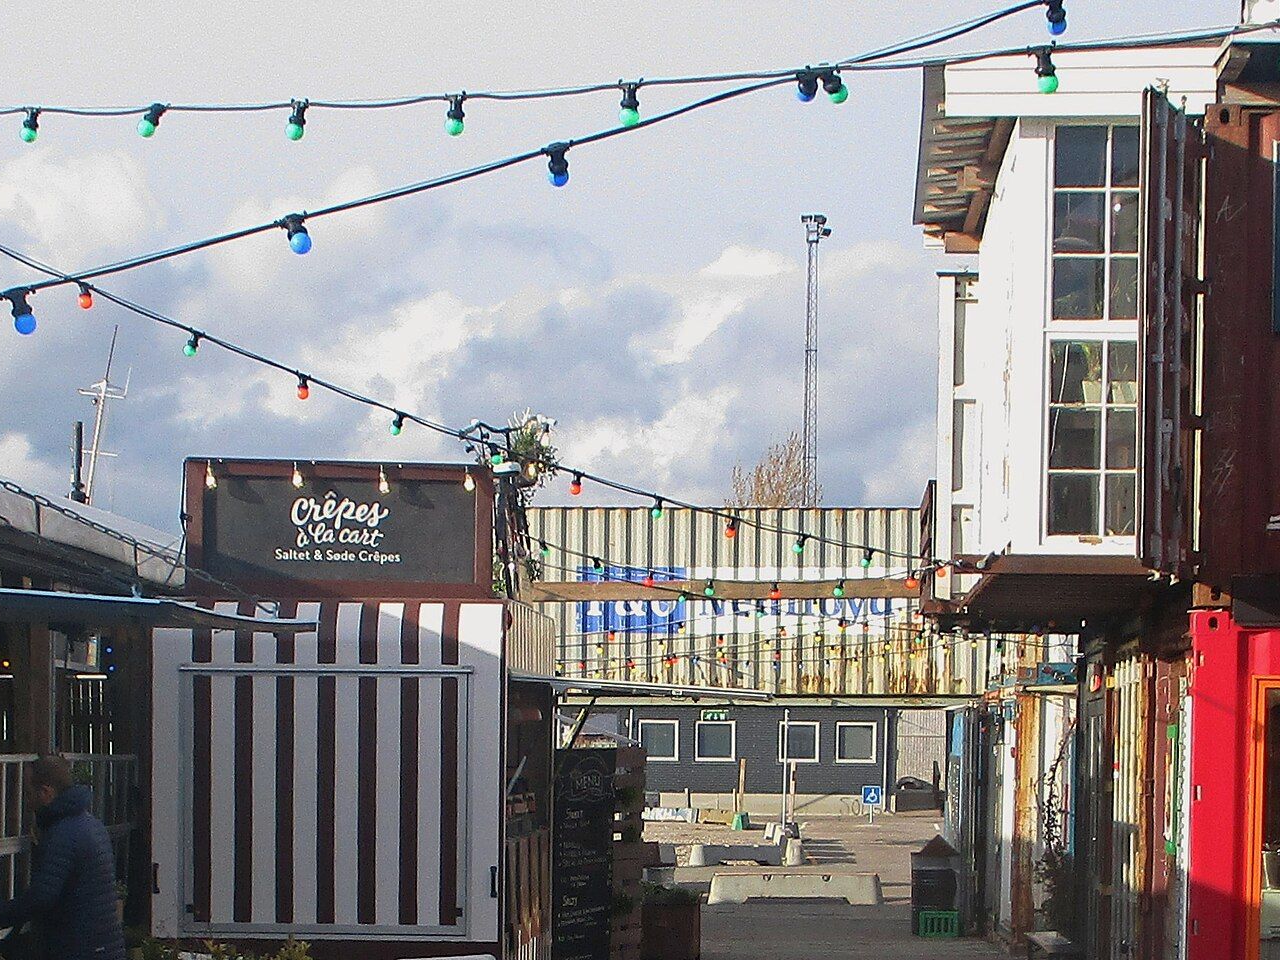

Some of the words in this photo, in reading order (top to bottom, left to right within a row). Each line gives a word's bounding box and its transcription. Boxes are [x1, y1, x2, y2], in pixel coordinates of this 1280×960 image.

[290, 491, 390, 528] Crêpes
[296, 525, 310, 547] à
[307, 522, 336, 545] la
[338, 525, 384, 547] cart
[274, 548, 311, 561] Saltet
[313, 549, 323, 561] &
[326, 549, 356, 562] Søde
[358, 549, 401, 565] Crêpes
